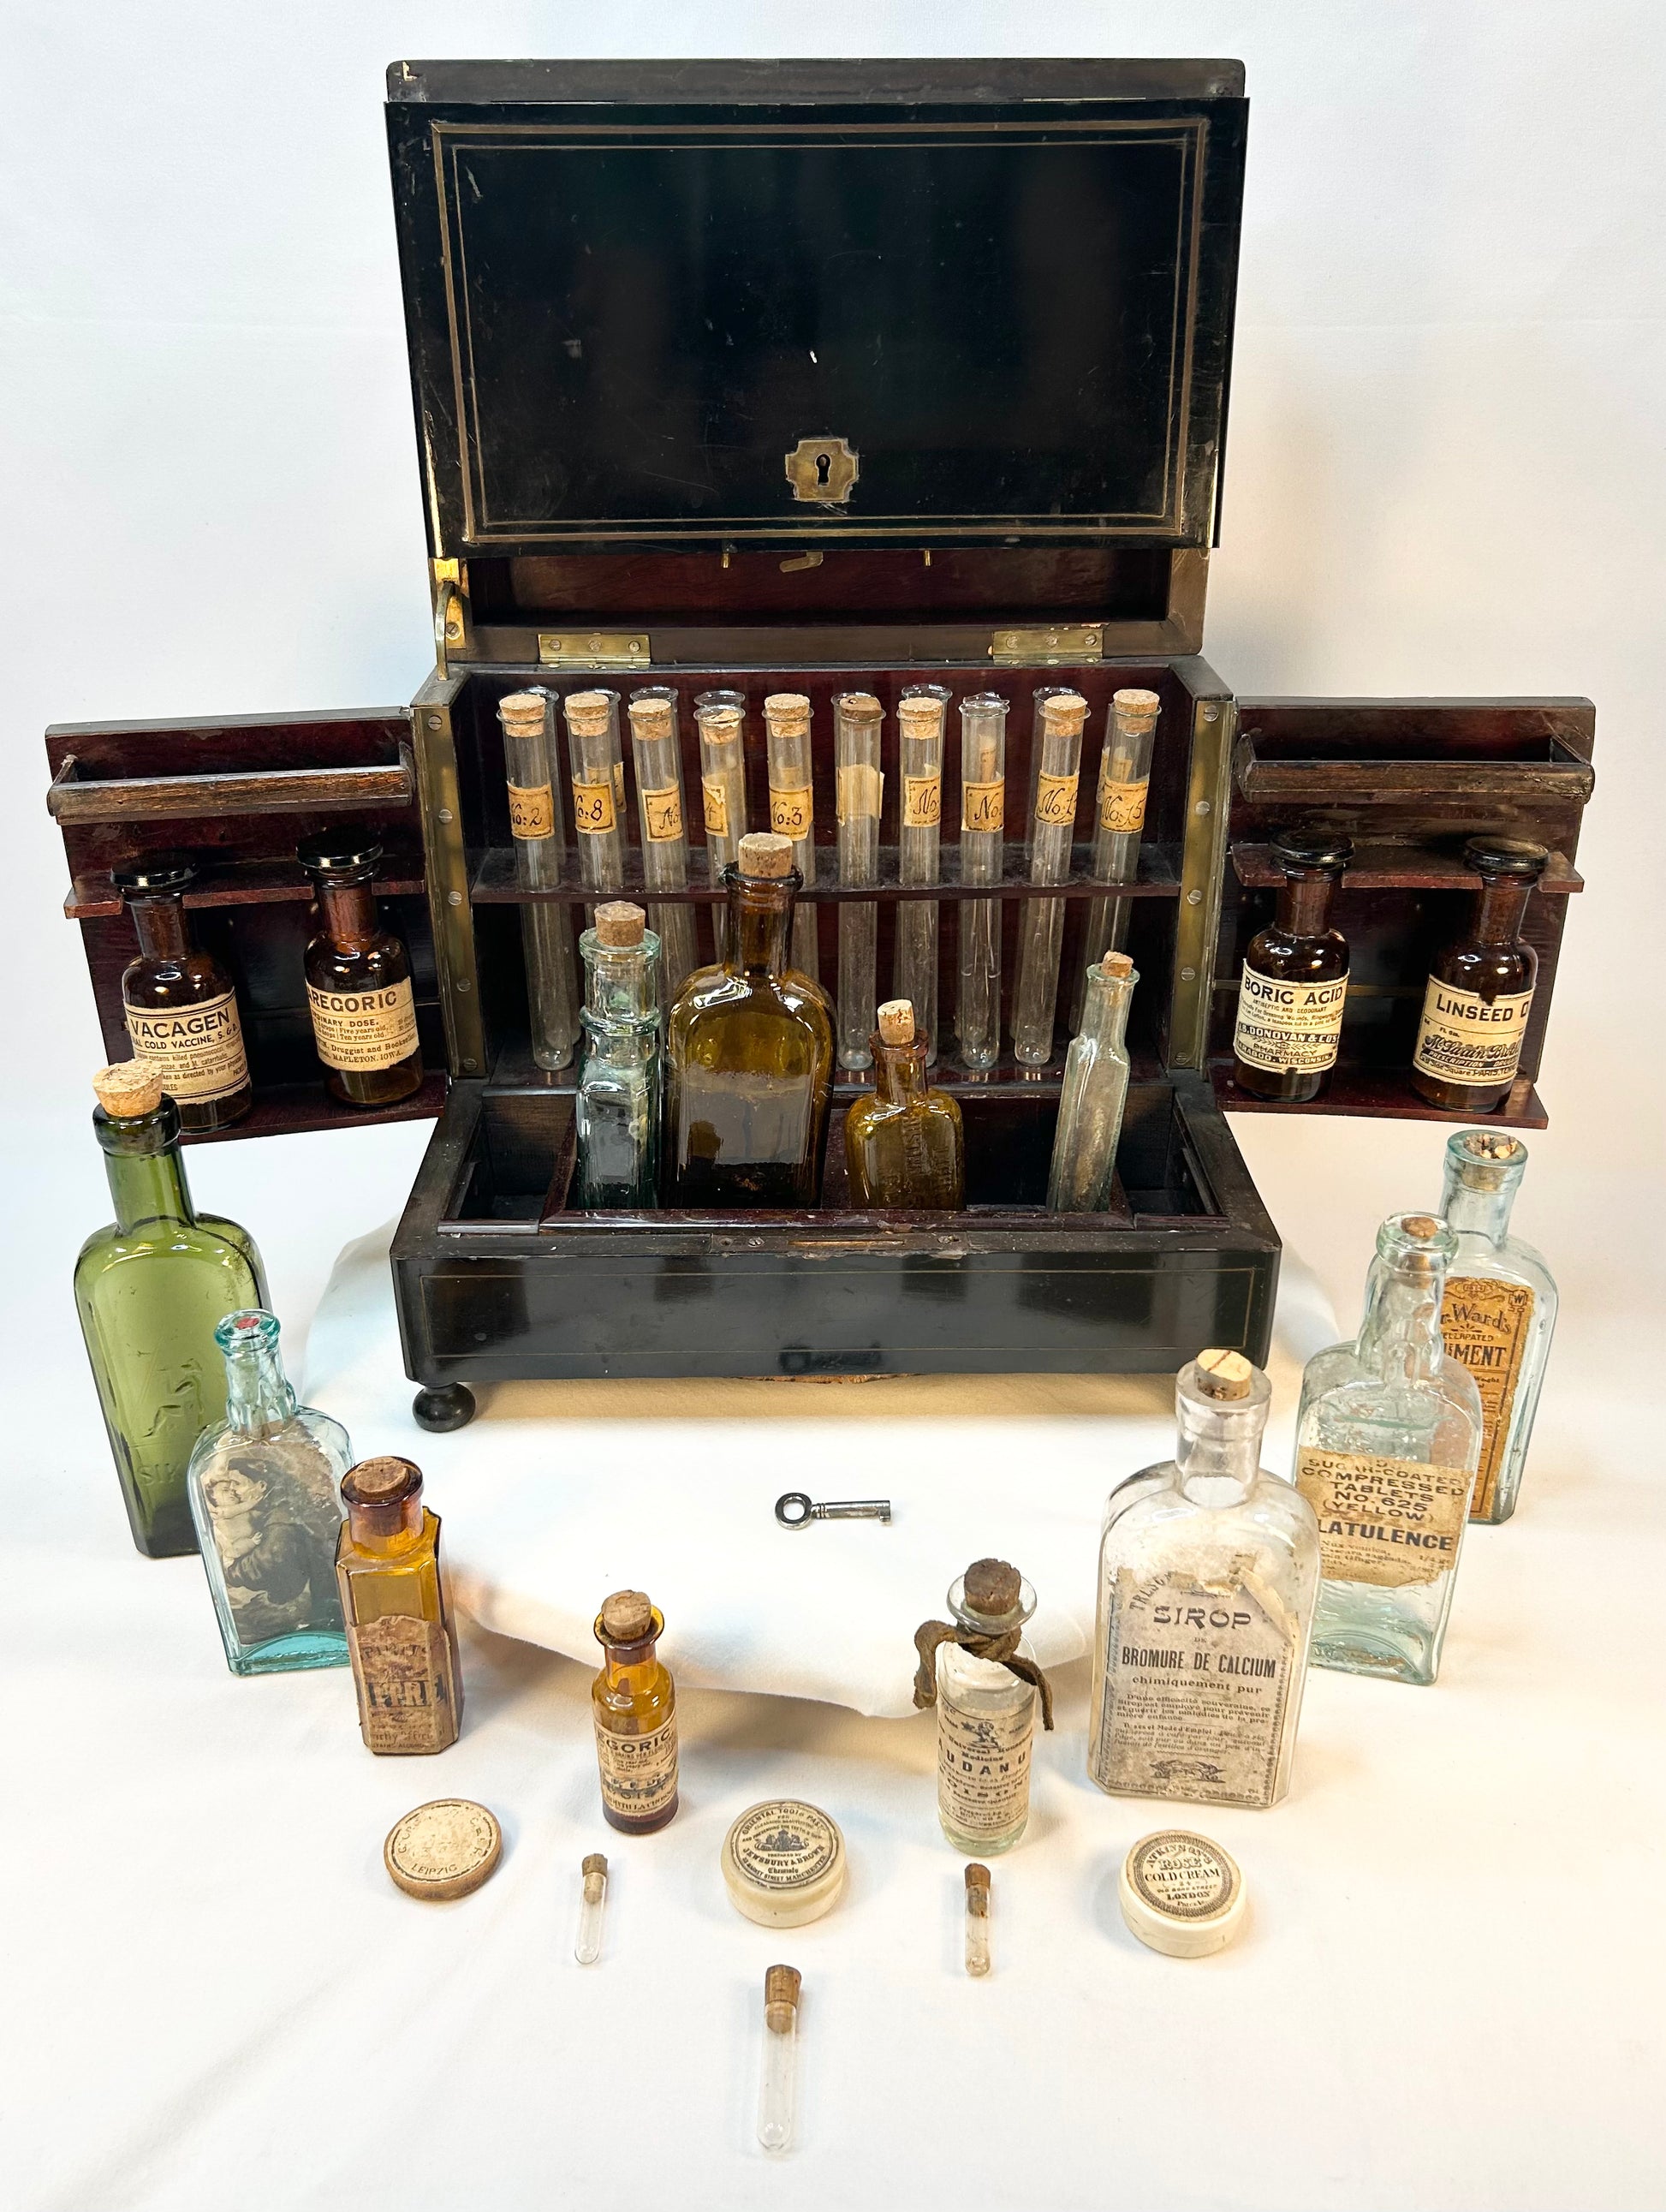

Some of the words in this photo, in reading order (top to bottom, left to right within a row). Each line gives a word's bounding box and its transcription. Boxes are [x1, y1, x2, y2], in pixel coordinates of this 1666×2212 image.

[1244, 975, 1294, 1005] BORIC
[1303, 987, 1343, 1005] ACID
[1253, 999, 1279, 1011] ANTISEPTIC
[1437, 993, 1514, 1022] LINSEED
[130, 1007, 231, 1039] VACAGEN
[349, 1019, 378, 1028] DOSE.
[144, 1040, 167, 1050] COLD
[171, 1034, 216, 1049] VACCINE,
[354, 1033, 373, 1042] years
[1308, 1034, 1318, 1043] &
[330, 1045, 365, 1055] Druggist
[366, 1045, 382, 1053] and
[1253, 1043, 1318, 1058] PHARMACY
[1428, 1051, 1483, 1068] PRESCRIPTION
[182, 1070, 205, 1079] directed
[207, 1067, 214, 1076] by
[1514, 1294, 1523, 1303] W
[1452, 1303, 1512, 1334] Ward's
[1301, 1466, 1465, 1496] COMPRESSED
[1330, 1482, 1434, 1503] TABLETS
[1334, 1491, 1375, 1504] NO.
[1381, 1497, 1428, 1512] 625
[1323, 1500, 1435, 1523] (YELLOW)
[1318, 1518, 1454, 1552] LATULENCE
[1153, 1605, 1252, 1630] SIROP
[1122, 1646, 1185, 1670] BROMURE
[1193, 1651, 1211, 1670] DE
[1218, 1655, 1276, 1678] CALCIUM
[1132, 1676, 1231, 1691] chimiquement
[1237, 1685, 1262, 1694] pur
[741, 1810, 776, 1834] ORIENTAL
[743, 1847, 788, 1867] JEWSBURY
[798, 1845, 825, 1864] BROWN
[1157, 1857, 1202, 1870] ROSE
[411, 1863, 458, 1875] LEIPZIG
[786, 1855, 827, 1881] MANCHESTER
[1145, 1872, 1178, 1882] COLD
[1180, 1869, 1220, 1880] CREAM
[1166, 1891, 1211, 1900] LONDON
